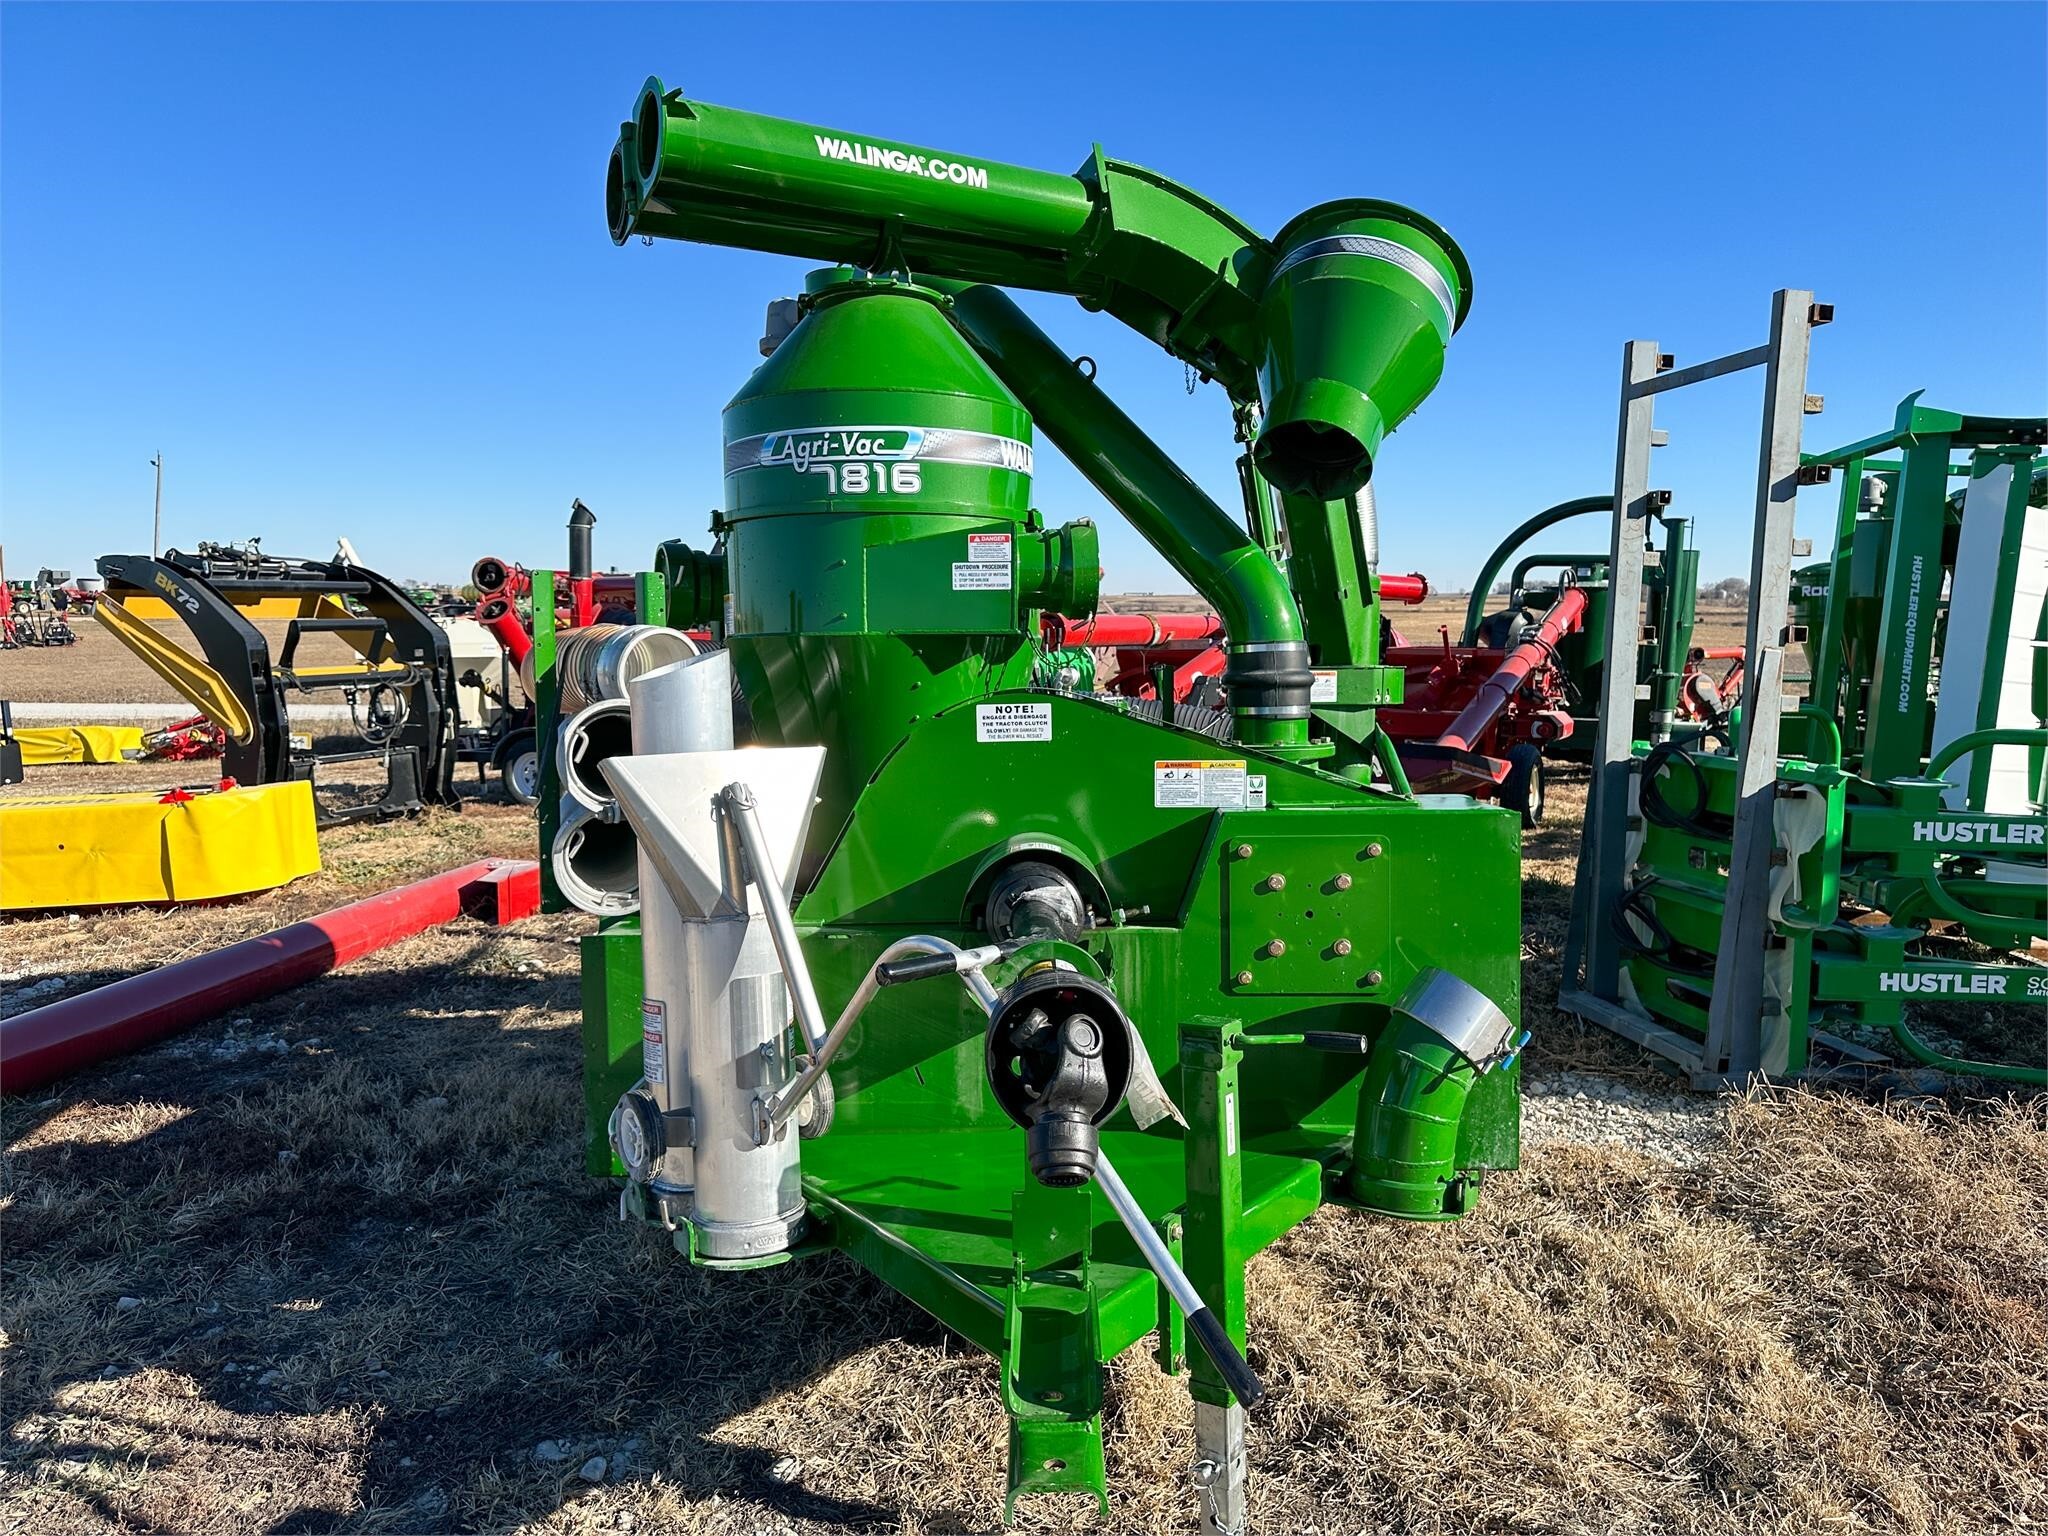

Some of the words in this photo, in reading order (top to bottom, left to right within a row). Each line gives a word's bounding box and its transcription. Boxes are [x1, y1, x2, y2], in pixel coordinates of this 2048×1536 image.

[781, 432, 886, 472] Agri-Vac
[809, 462, 922, 495] 7816
[155, 571, 200, 614] BK72
[1898, 555, 1923, 712] HUSTLEREQUIPMENT.COM
[995, 705, 1034, 714] NOTE!
[1913, 821, 2045, 844] HUSTLER
[1880, 972, 2007, 994] HUSTLER
